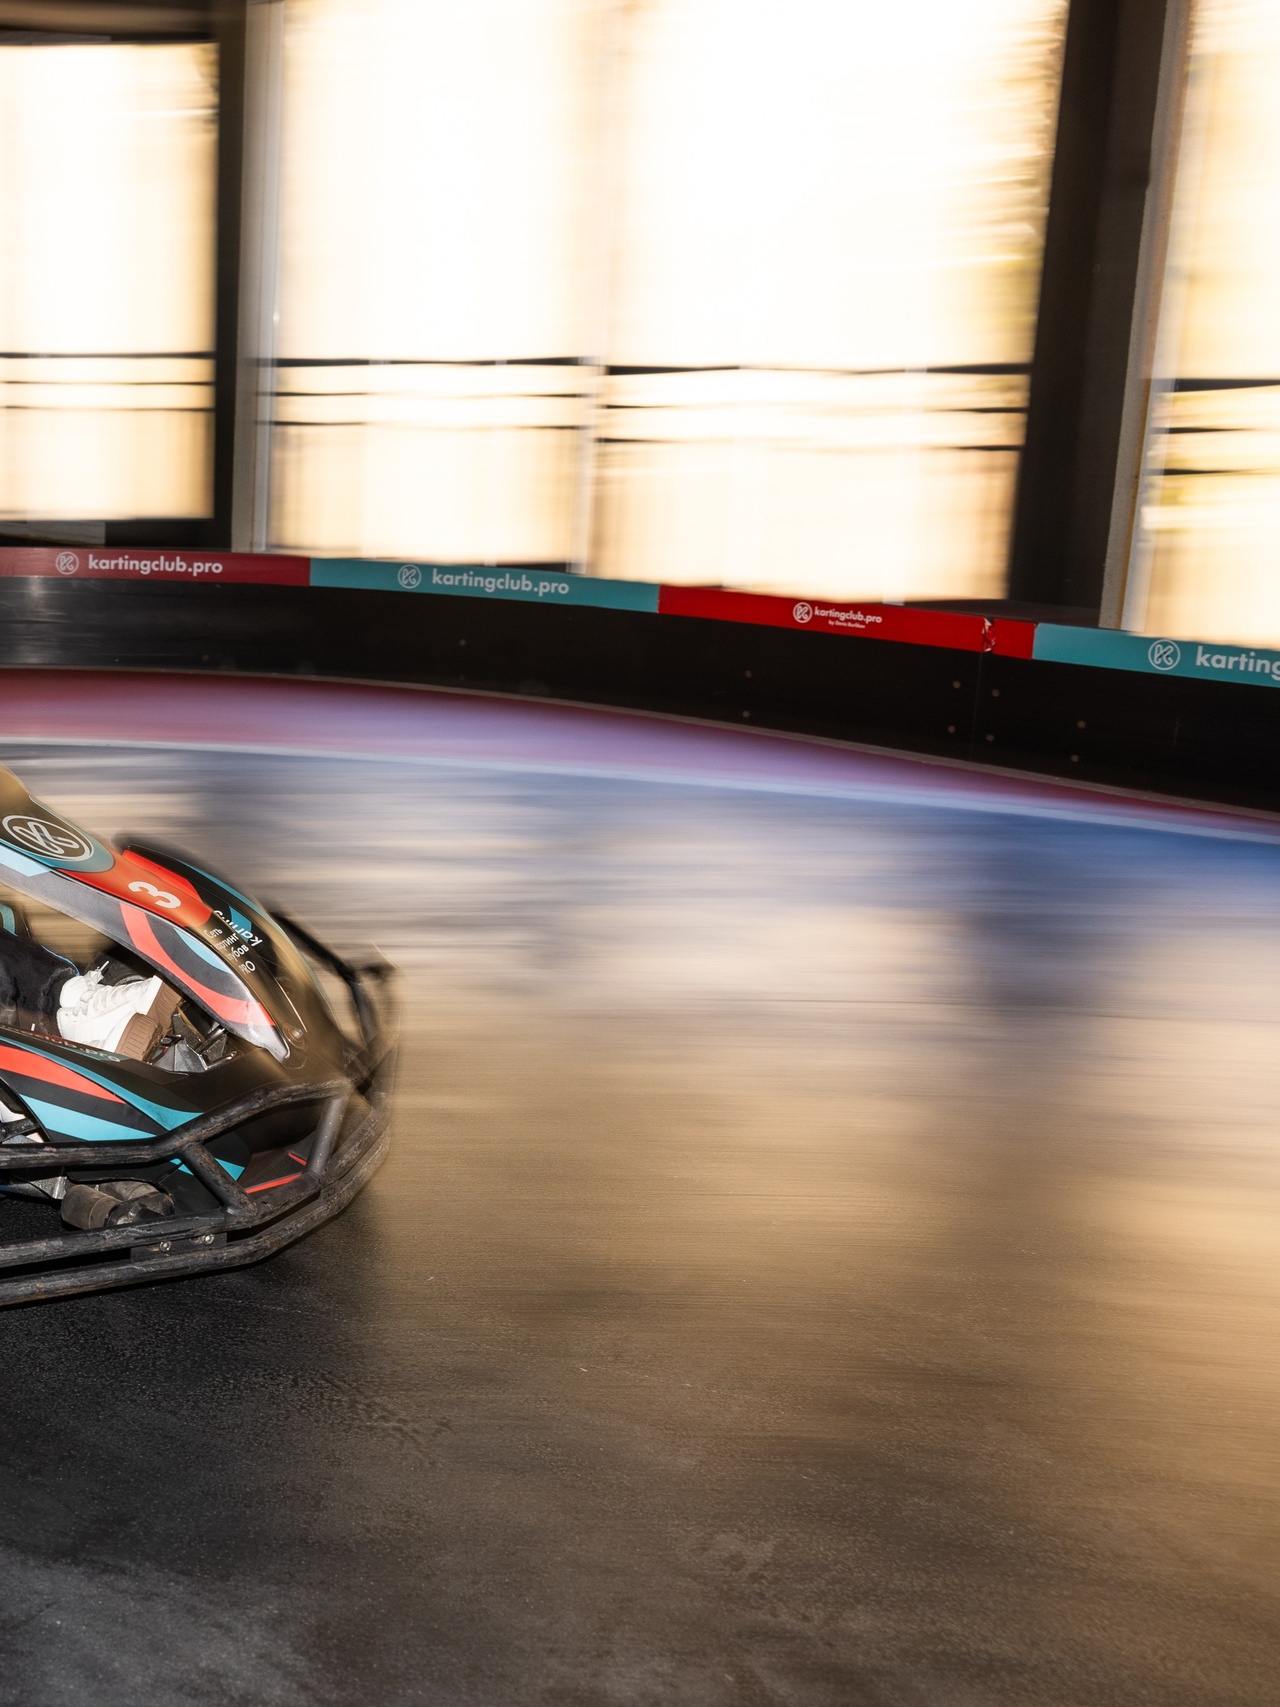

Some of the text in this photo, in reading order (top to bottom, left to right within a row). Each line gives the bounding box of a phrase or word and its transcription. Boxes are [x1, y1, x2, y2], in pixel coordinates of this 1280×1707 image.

[88, 554, 223, 577] kartingclub.pro
[432, 568, 569, 597] kartingclub.pro
[814, 606, 882, 624] kartingclub.pro
[128, 881, 182, 909] 3
